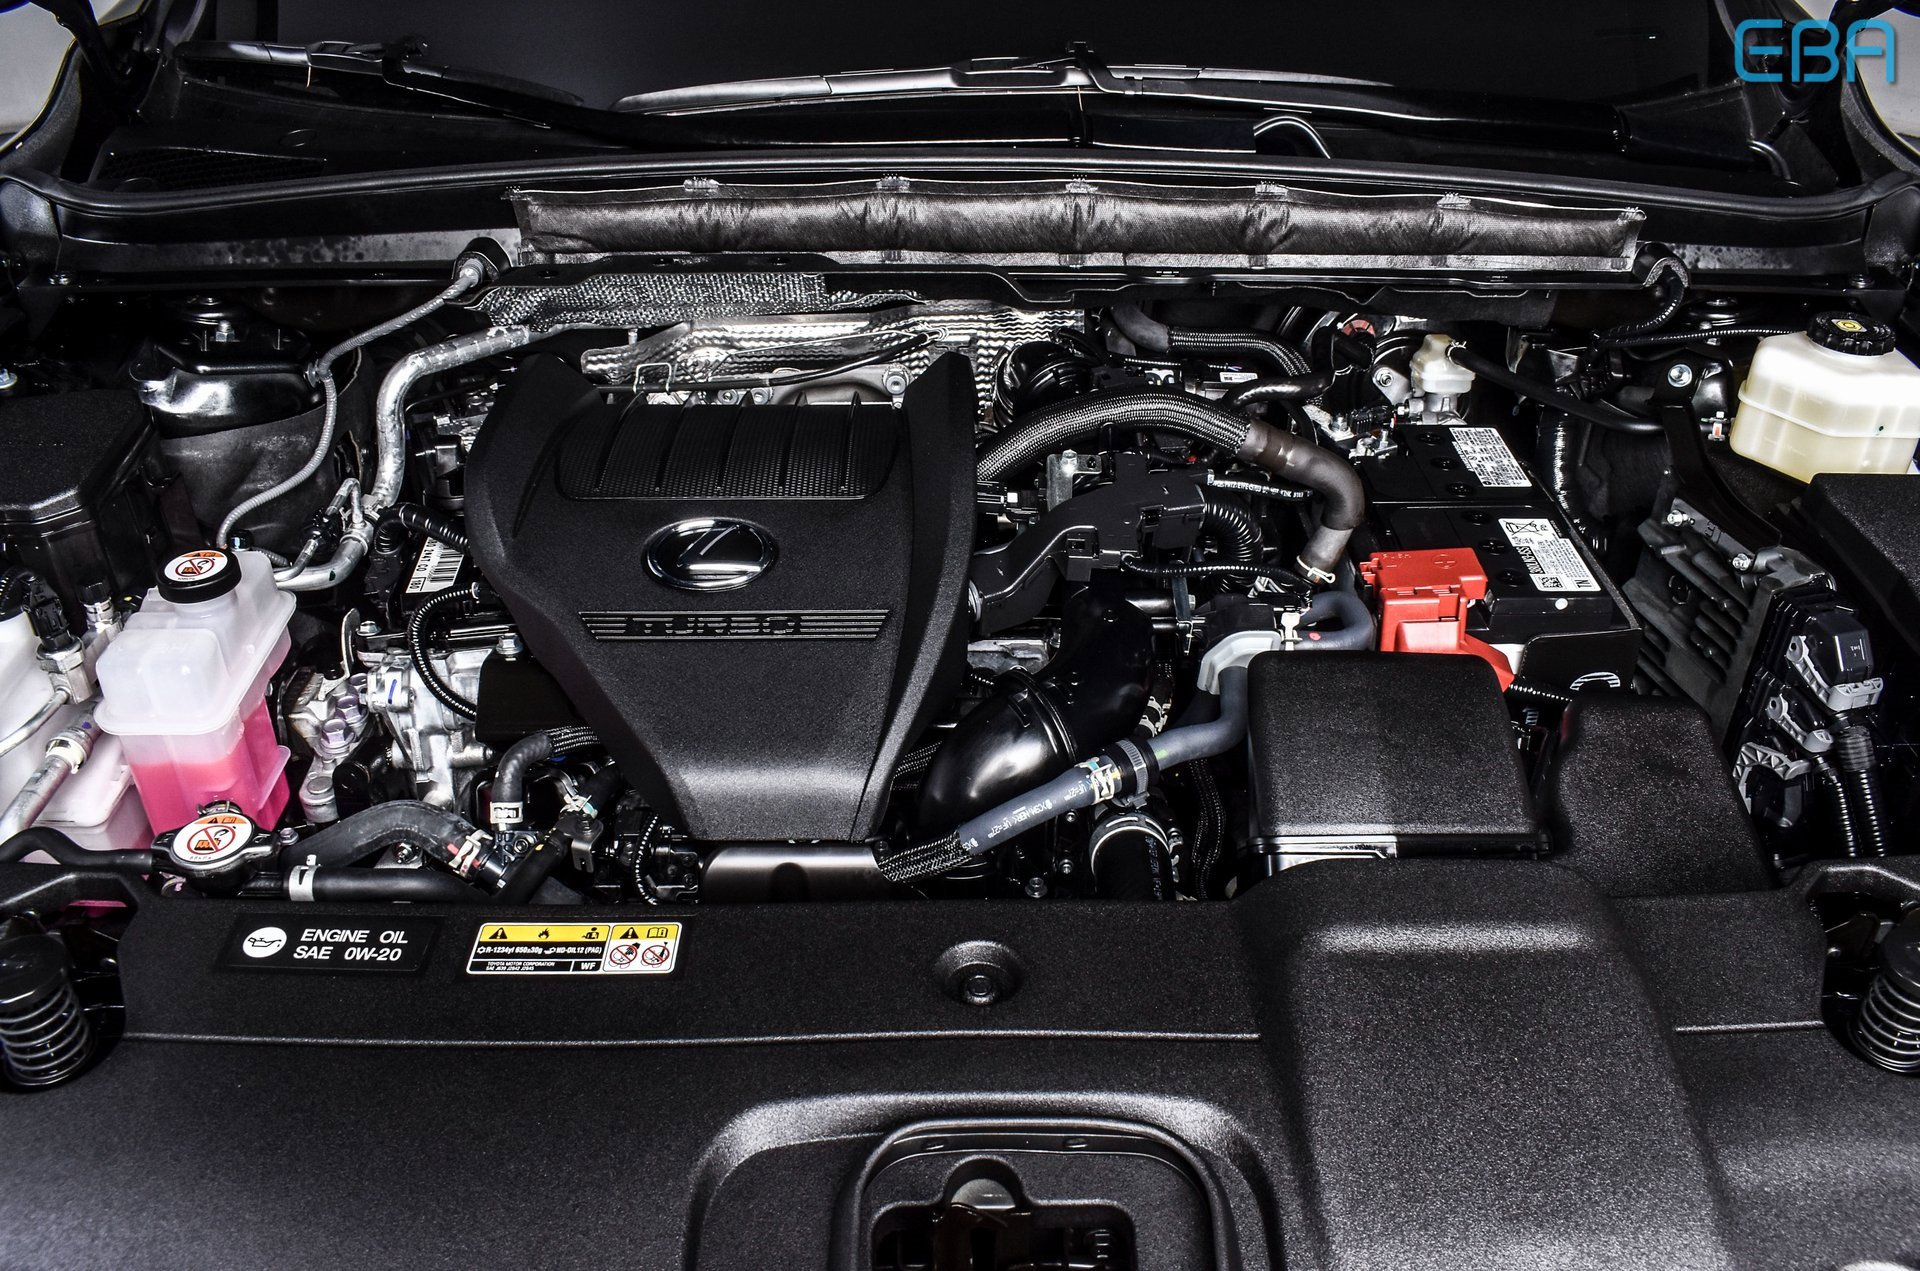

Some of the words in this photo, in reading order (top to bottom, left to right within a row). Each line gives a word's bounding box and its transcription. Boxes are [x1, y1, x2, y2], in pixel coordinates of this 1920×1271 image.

[631, 616, 796, 634] TURBO
[300, 928, 370, 943] ENGINE
[379, 930, 408, 944] OIL
[293, 945, 333, 960] SAE
[344, 947, 402, 961] 0W-20
[580, 962, 597, 971] WF
